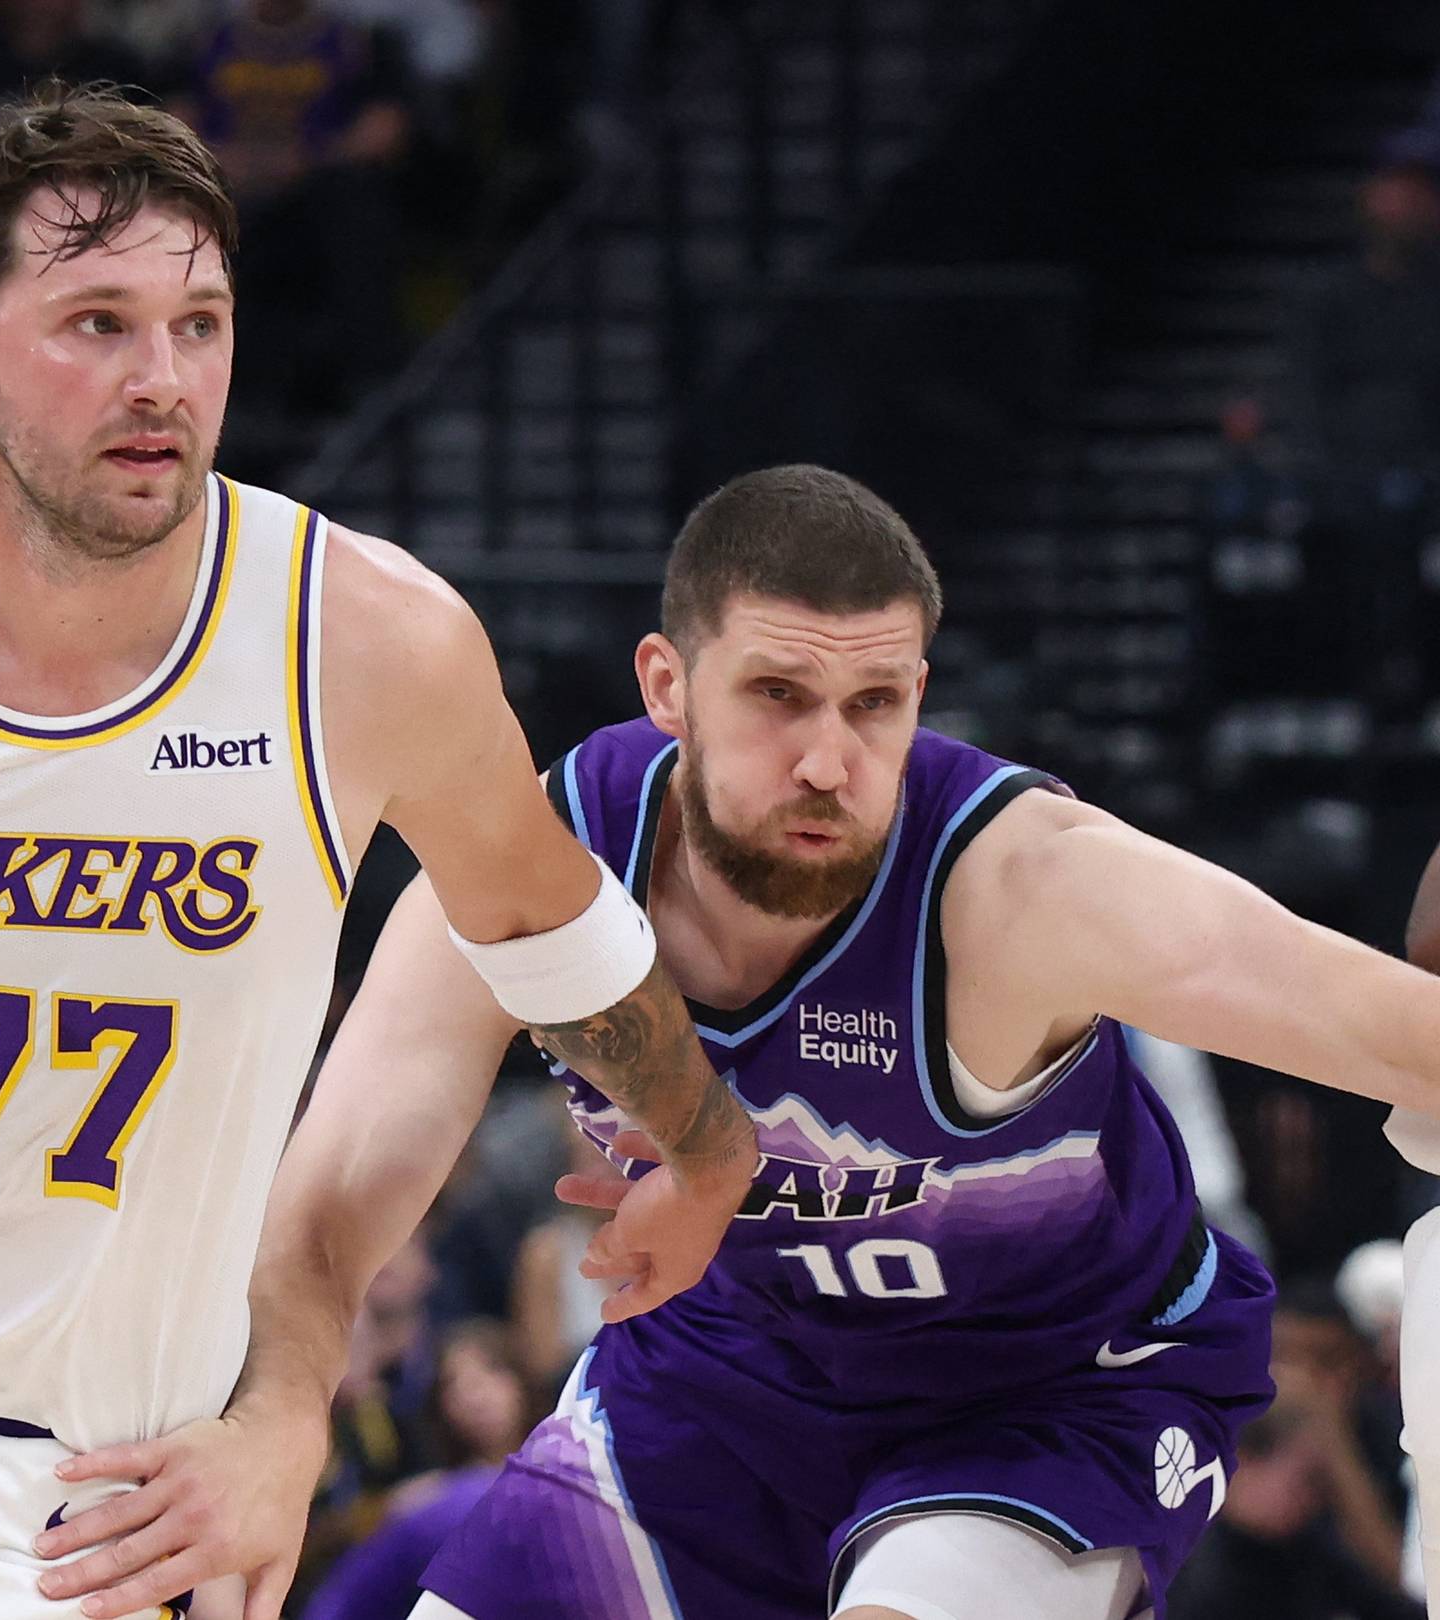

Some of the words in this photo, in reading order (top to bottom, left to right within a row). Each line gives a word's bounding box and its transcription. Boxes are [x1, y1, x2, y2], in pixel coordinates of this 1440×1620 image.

[150, 732, 272, 770] Albert
[798, 1003, 898, 1040] Health
[799, 1034, 899, 1074] Equity
[731, 1152, 943, 1222] AH
[776, 1238, 948, 1299] 10
